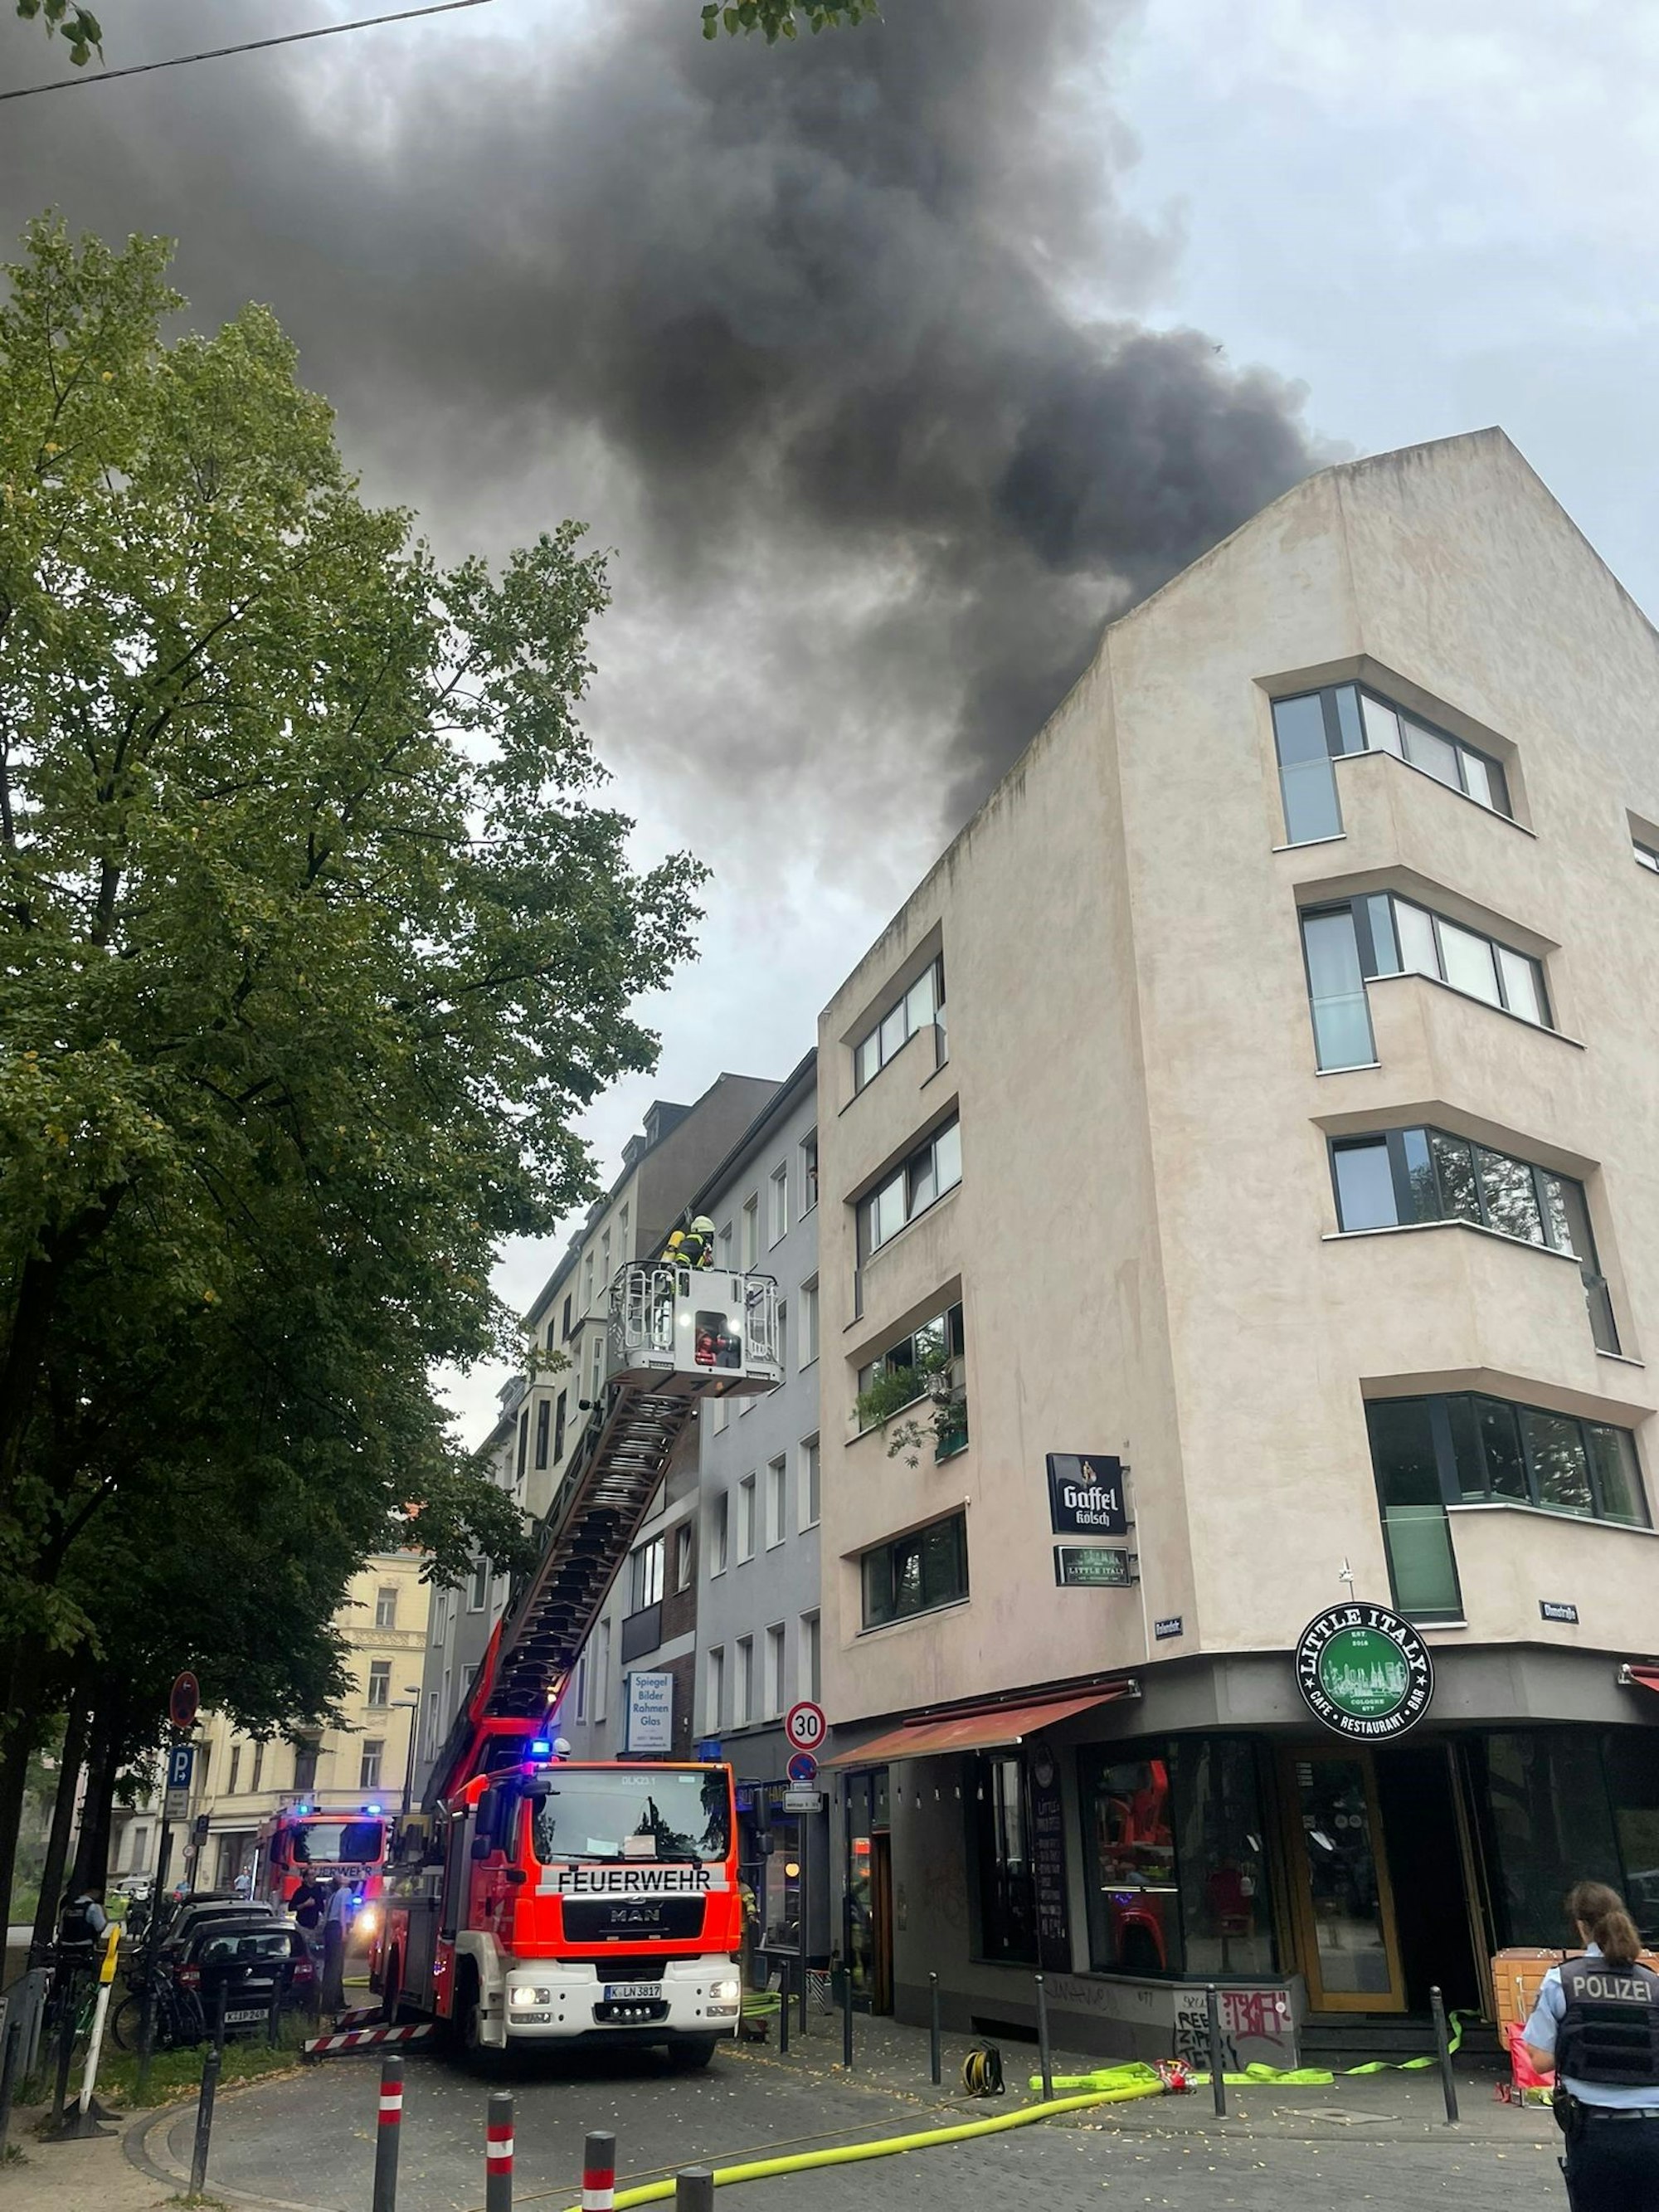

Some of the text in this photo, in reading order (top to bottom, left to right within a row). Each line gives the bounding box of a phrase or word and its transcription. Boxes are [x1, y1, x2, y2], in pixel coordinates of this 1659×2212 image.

[1063, 1485, 1118, 1511] Gaffel
[1076, 1510, 1110, 1527] Kölsch
[1300, 1608, 1428, 1675] LITTLE ITALY
[635, 1676, 667, 1688] Spiegel
[639, 1690, 664, 1700] Bilder
[633, 1703, 669, 1713] Rahmen
[1310, 1688, 1426, 1734] CAFE RESTAURANT BAR
[640, 1715, 661, 1726] Glas
[795, 1715, 817, 1737] 30
[557, 1870, 711, 1893] FEUERWEHR
[611, 1909, 660, 1922] MAN
[1573, 1976, 1652, 2002] POLIZEI
